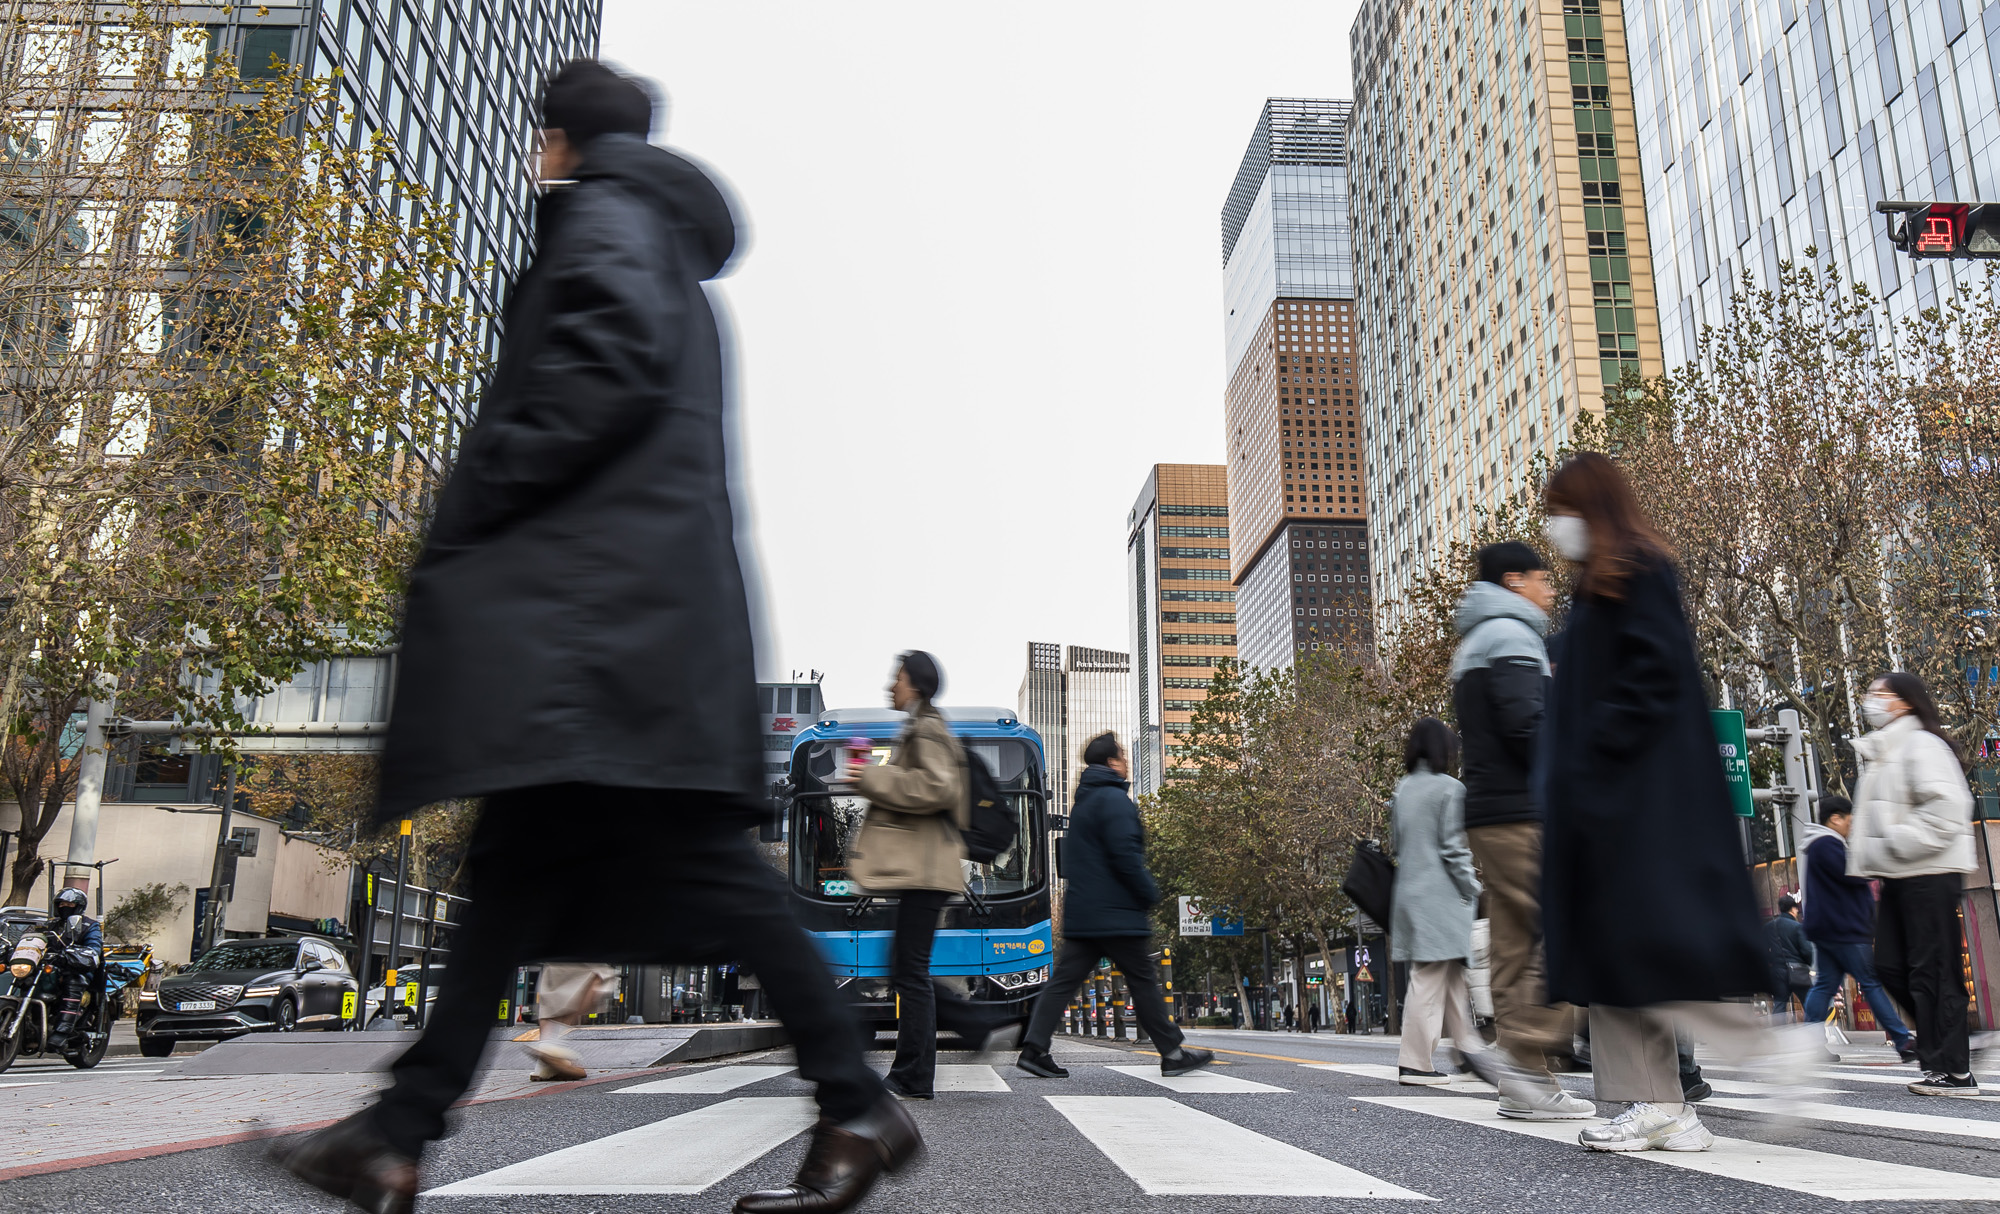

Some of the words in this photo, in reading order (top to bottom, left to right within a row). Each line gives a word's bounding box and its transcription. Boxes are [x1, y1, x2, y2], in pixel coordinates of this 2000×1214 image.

[1725, 758, 1746, 772] 化門
[993, 942, 1027, 955] 천연가스버스
[1029, 943, 1044, 951] CNG
